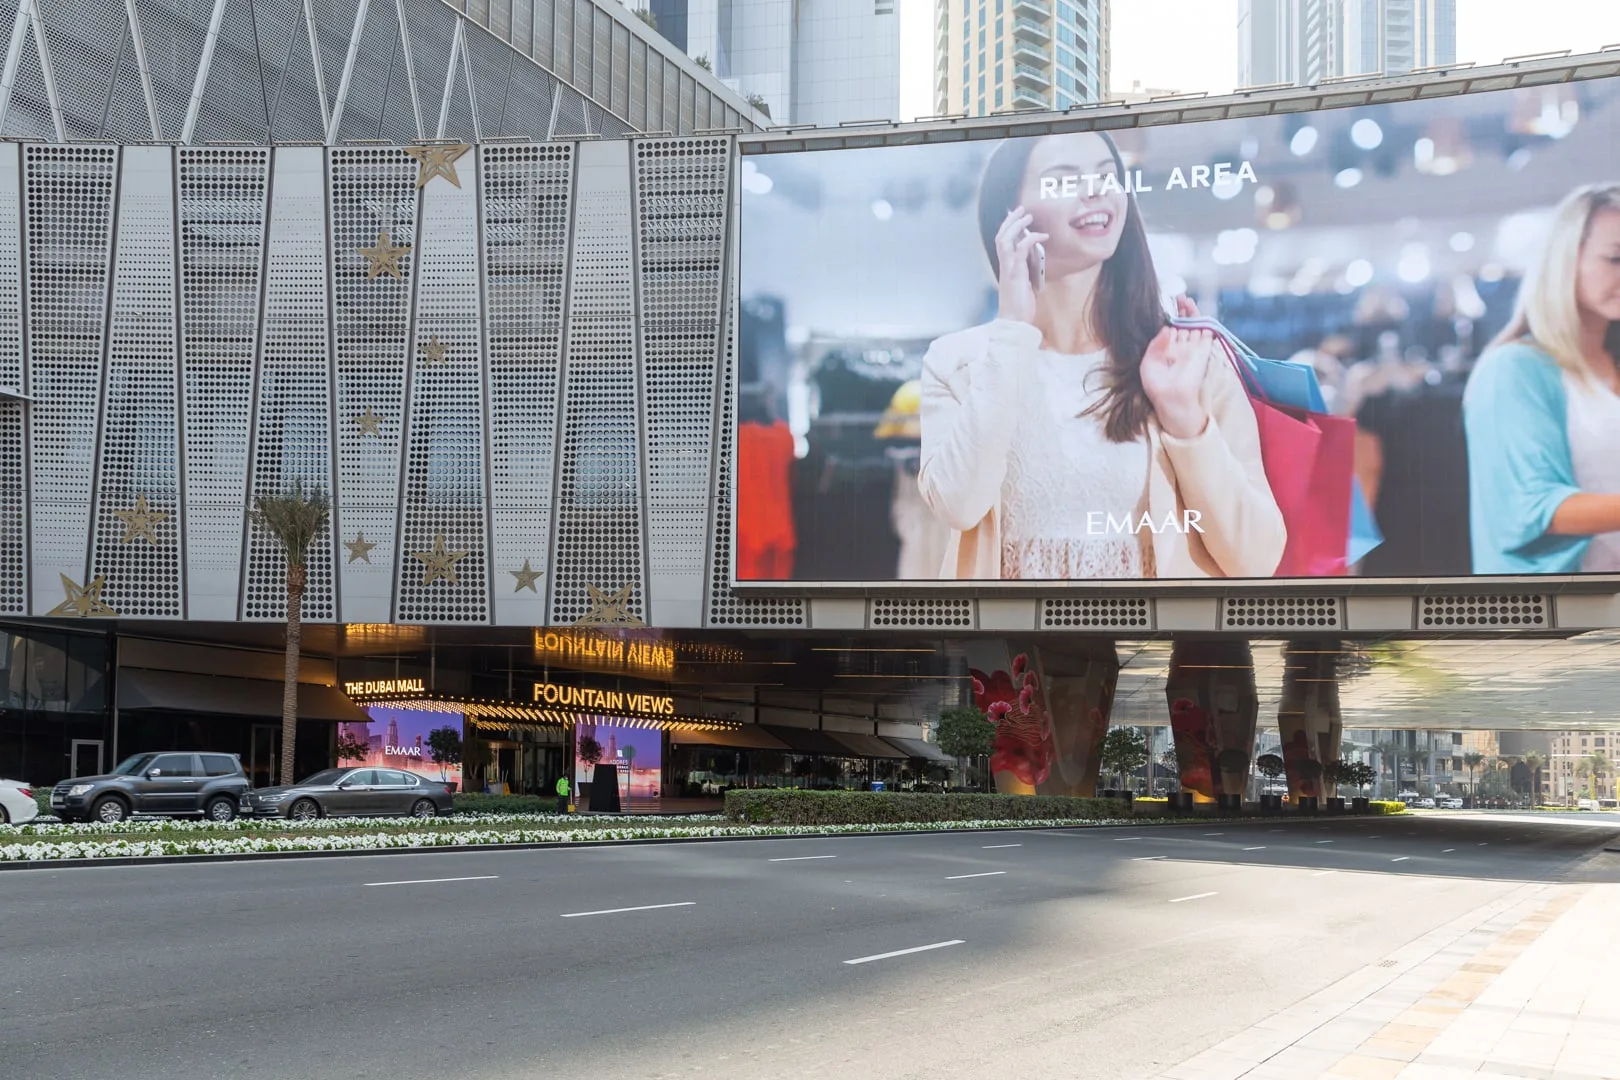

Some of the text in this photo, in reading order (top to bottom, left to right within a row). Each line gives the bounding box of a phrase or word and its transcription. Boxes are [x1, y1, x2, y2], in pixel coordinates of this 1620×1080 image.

[1040, 161, 1258, 200] RETAIL AREA
[1086, 509, 1206, 535] EMAAR
[345, 678, 425, 695] THE DUBAI MALL
[533, 682, 674, 714] FOUNTAIN VIEWS
[385, 745, 421, 756] EMAAR
